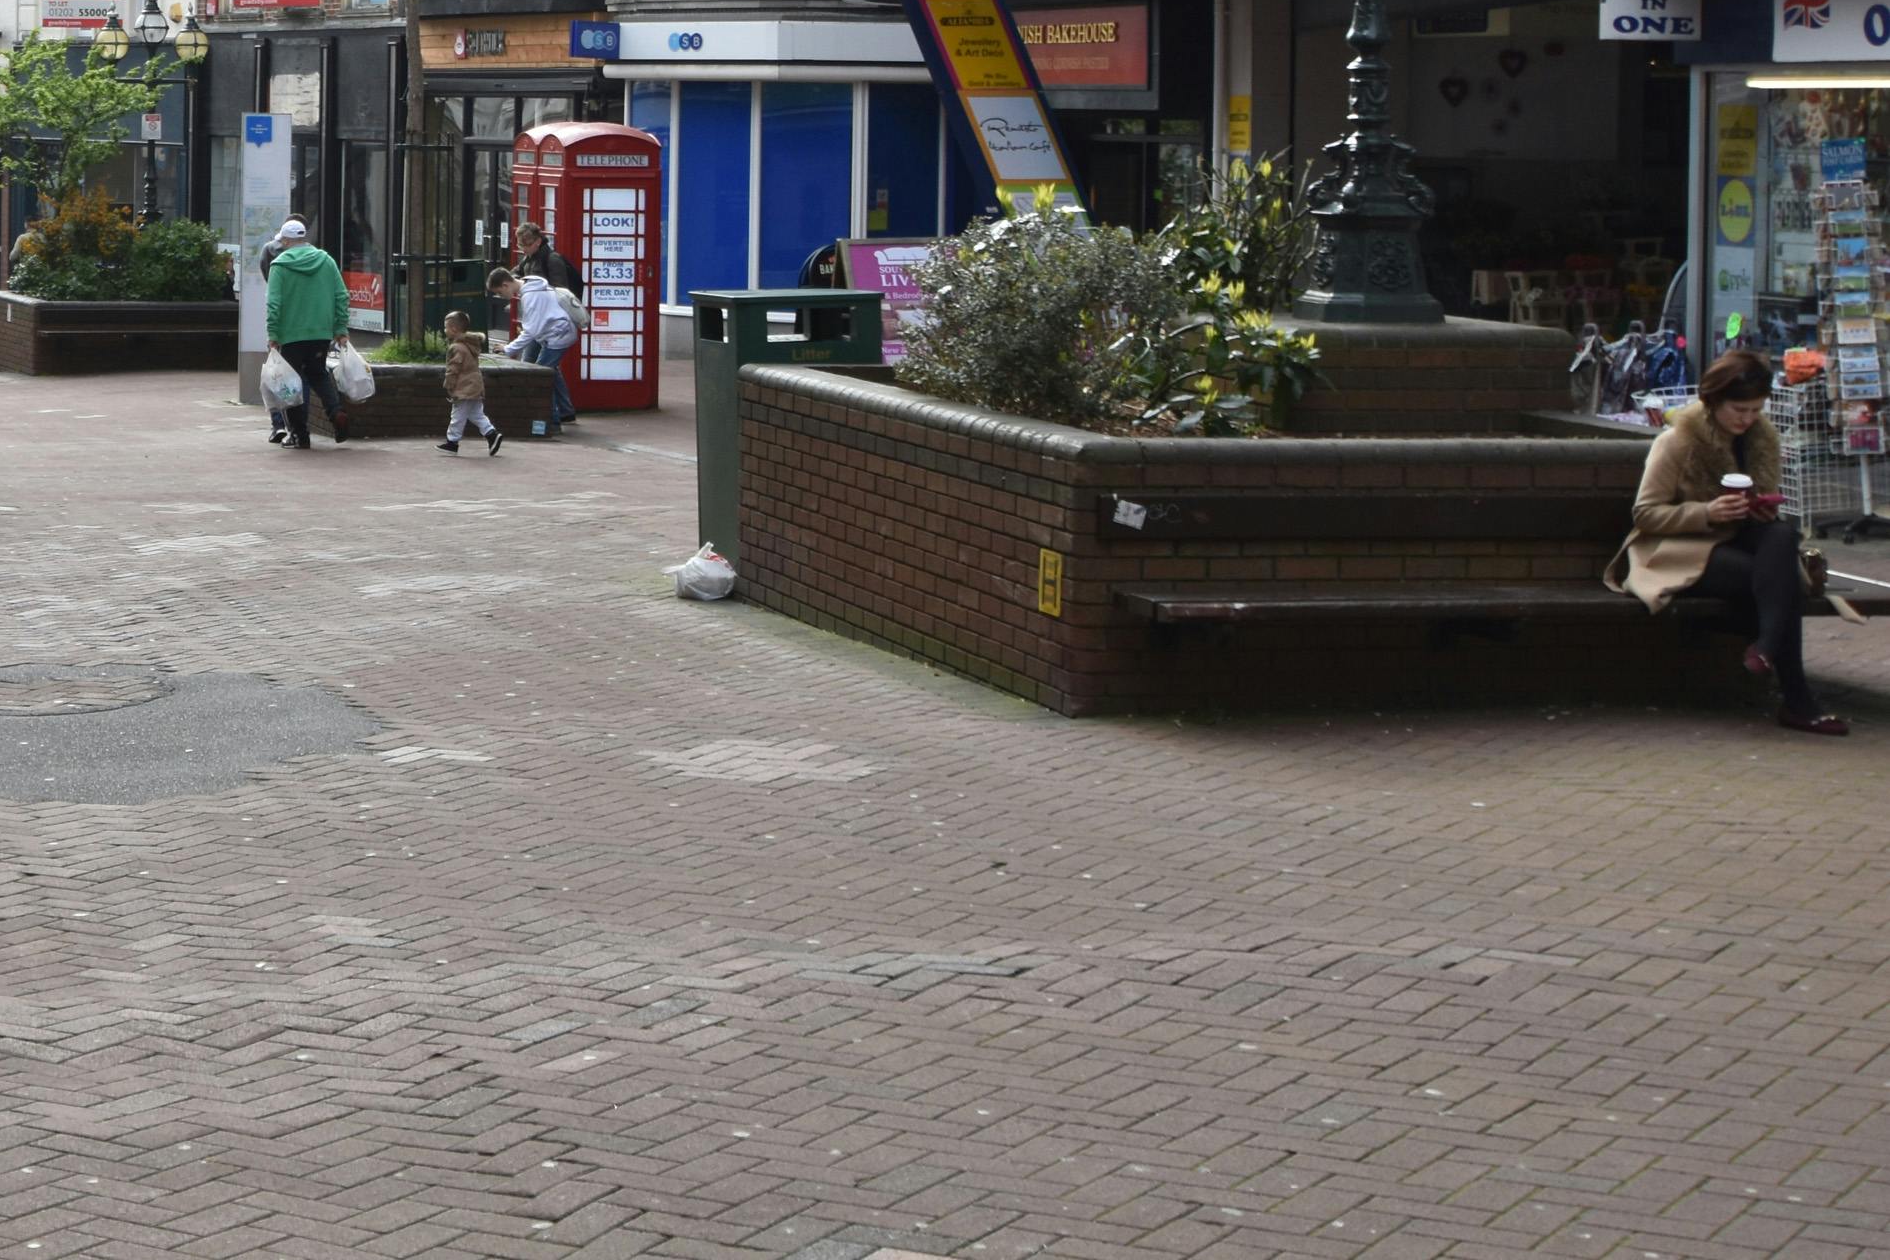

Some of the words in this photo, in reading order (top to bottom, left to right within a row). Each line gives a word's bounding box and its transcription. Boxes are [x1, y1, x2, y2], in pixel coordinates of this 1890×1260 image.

[78, 7, 110, 18] 55000
[1612, 15, 1694, 35] ONE
[1046, 22, 1116, 44] BAKEHOUSE
[580, 155, 646, 166] TELEPHONE
[593, 217, 635, 228] LOOK!
[593, 267, 633, 280] £3.33
[594, 289, 611, 297] PER
[613, 289, 631, 297] DAY
[792, 347, 831, 362] Litter
